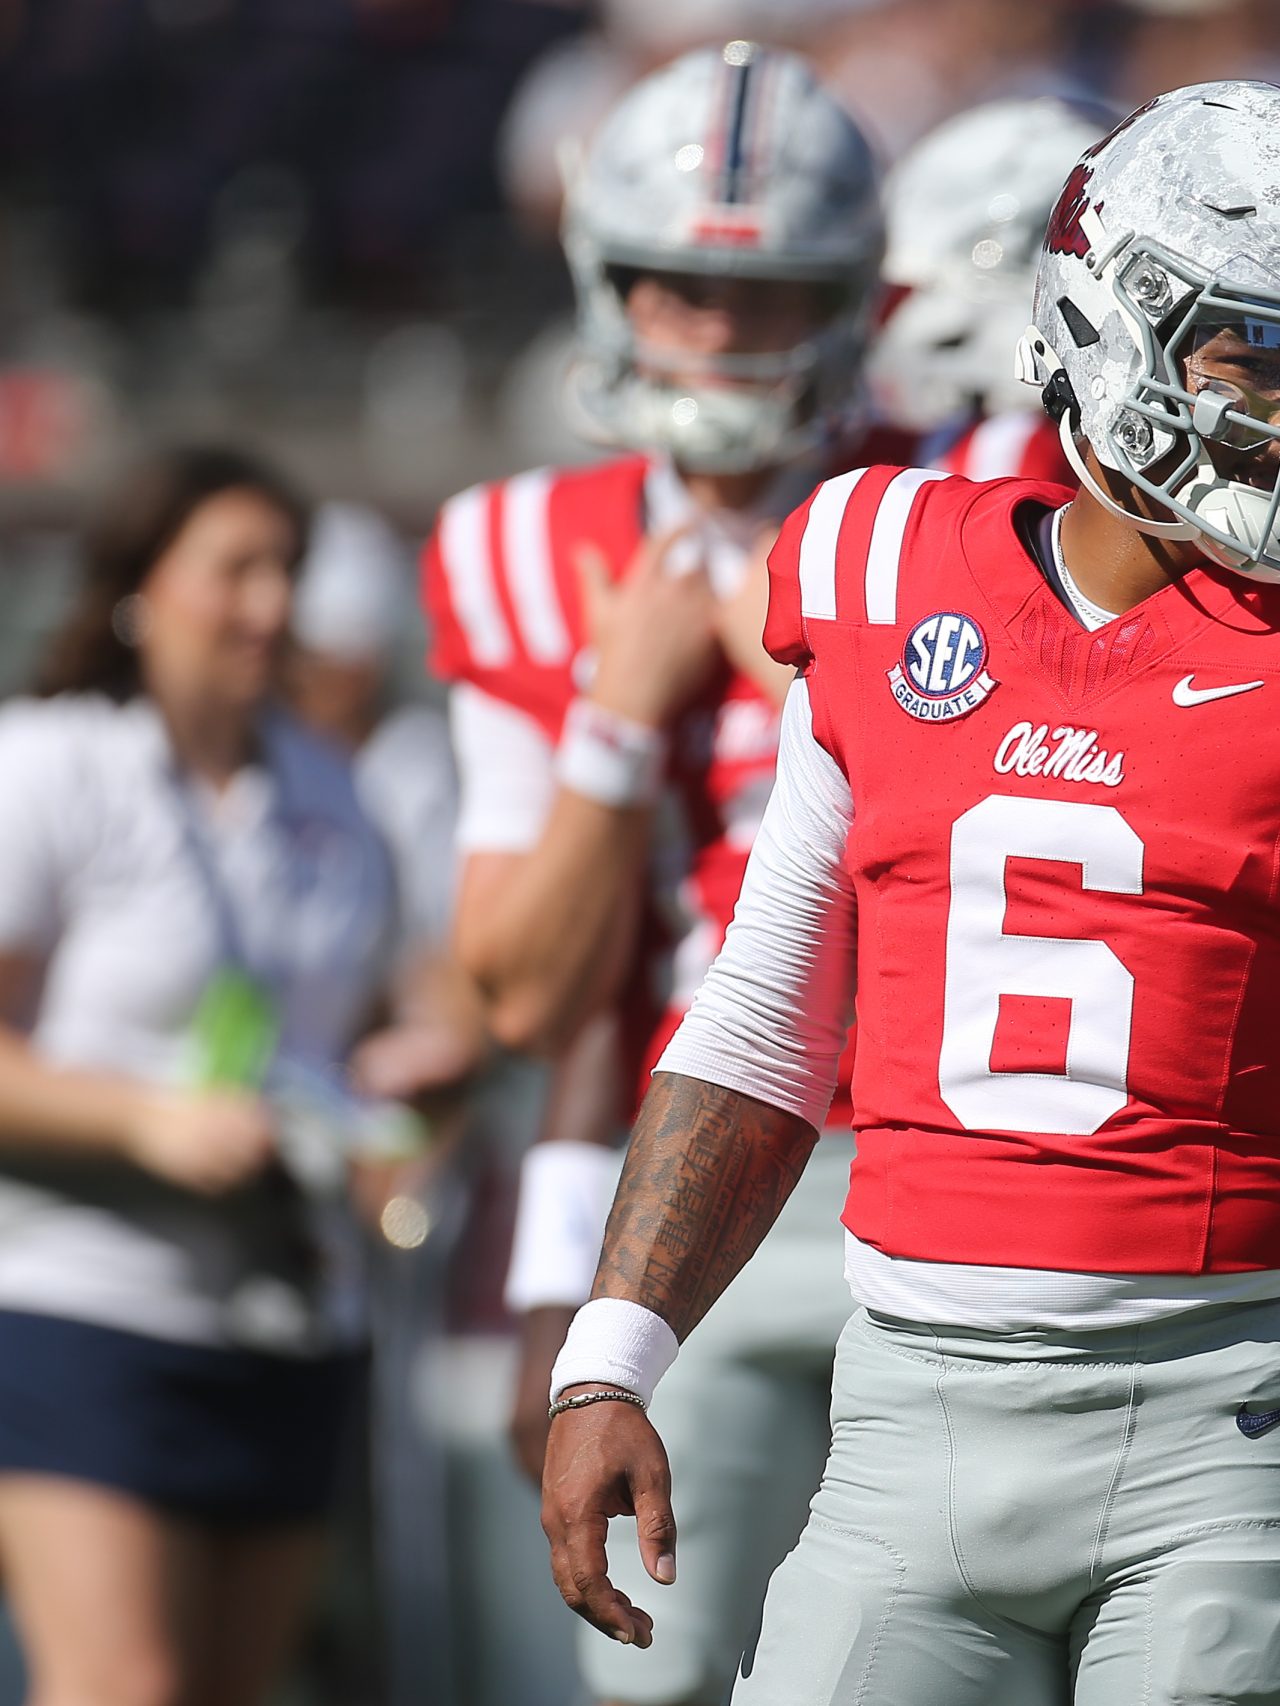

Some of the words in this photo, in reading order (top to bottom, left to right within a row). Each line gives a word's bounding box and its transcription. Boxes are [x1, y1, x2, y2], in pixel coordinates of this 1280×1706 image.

[908, 615, 981, 692] SEC
[895, 684, 977, 719] GRADUATE
[993, 721, 1048, 774] Ole
[1043, 727, 1125, 787] Miss
[938, 794, 1145, 1135] 6
